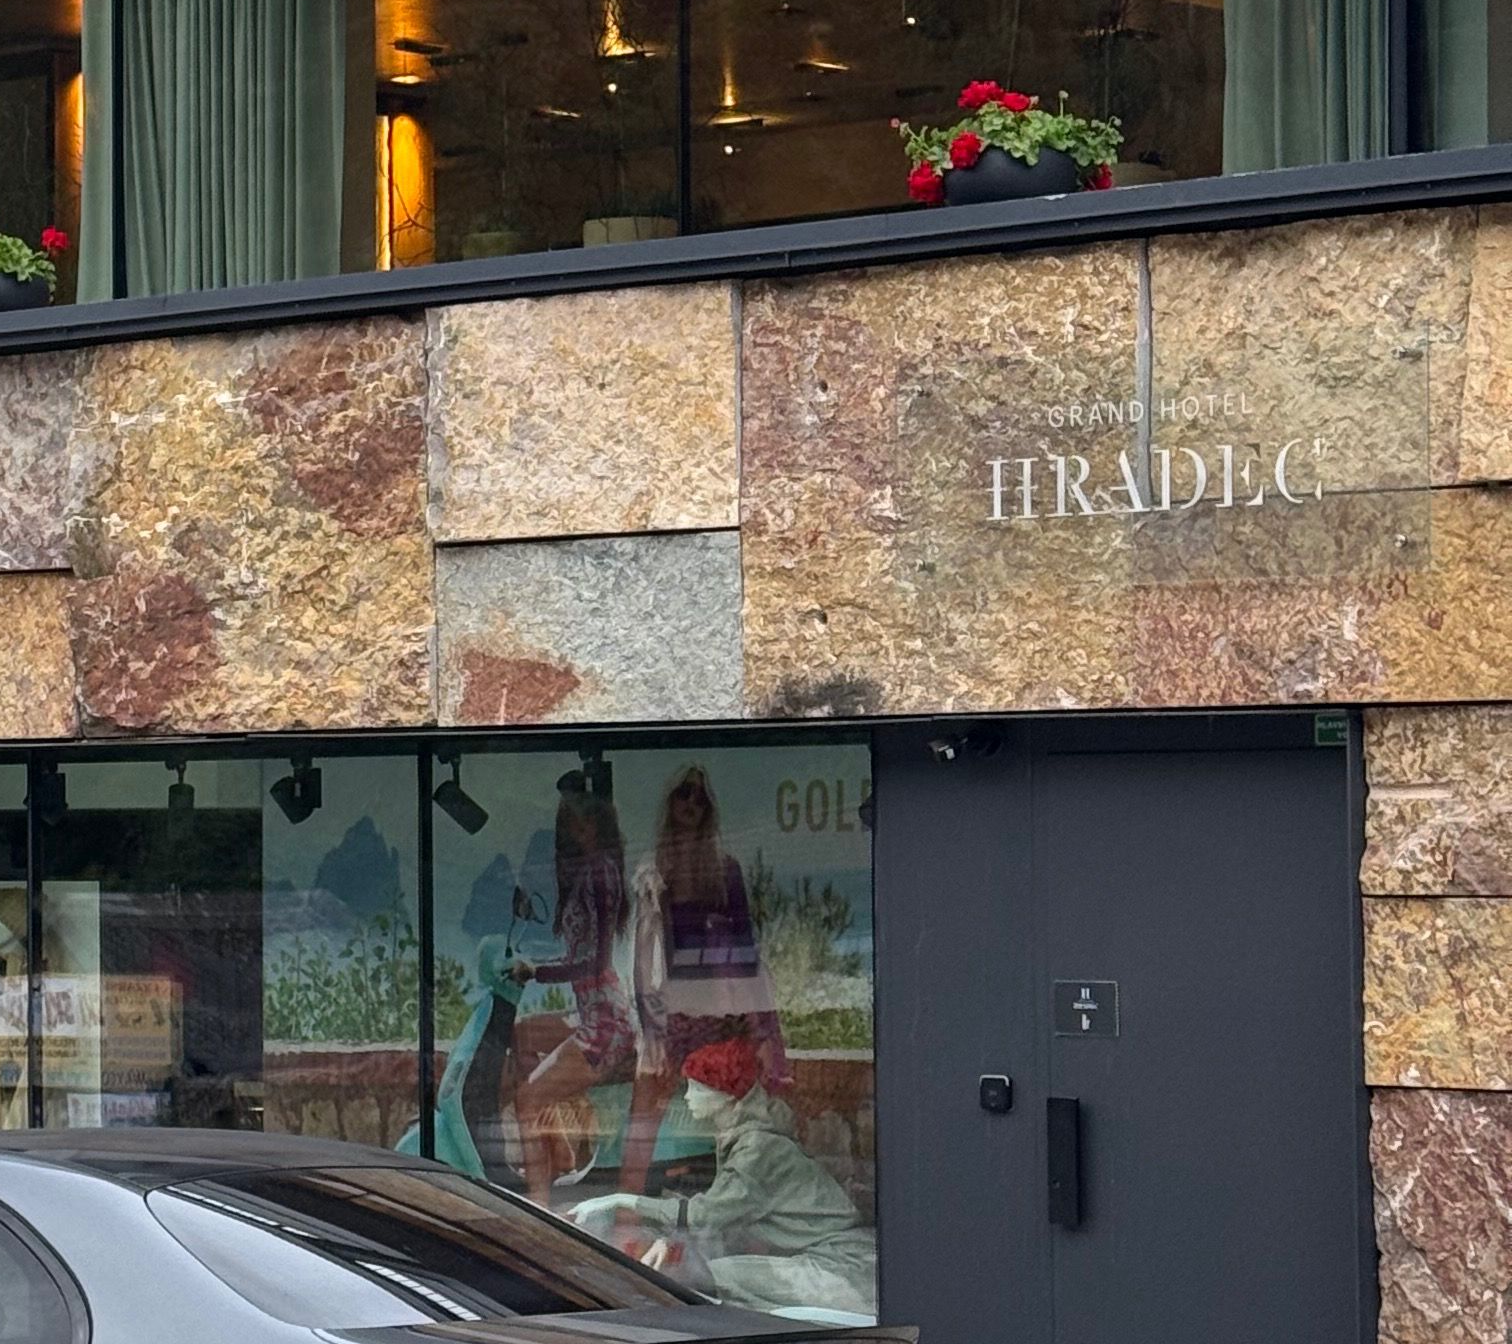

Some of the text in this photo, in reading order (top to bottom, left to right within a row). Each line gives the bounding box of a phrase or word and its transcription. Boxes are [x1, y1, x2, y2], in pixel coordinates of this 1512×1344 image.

[1048, 391, 1254, 429] GRAND HOTEL
[985, 438, 1326, 522] HRADEC
